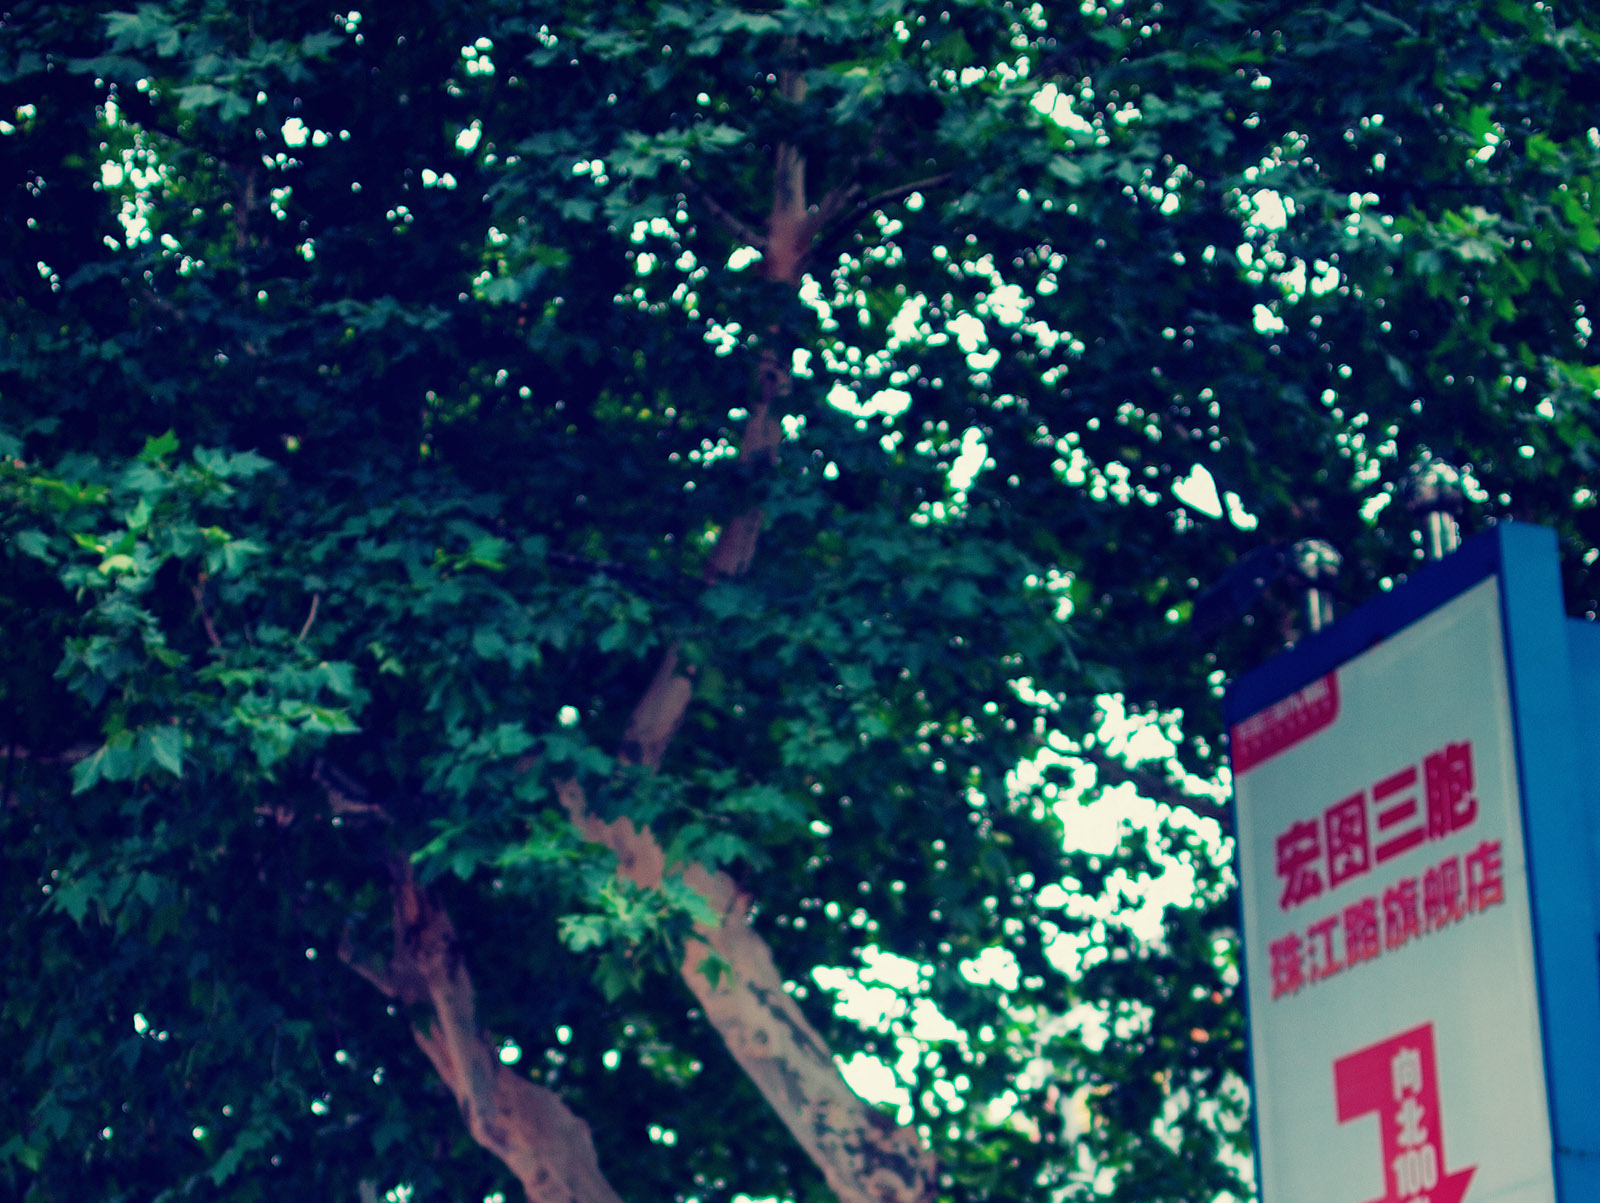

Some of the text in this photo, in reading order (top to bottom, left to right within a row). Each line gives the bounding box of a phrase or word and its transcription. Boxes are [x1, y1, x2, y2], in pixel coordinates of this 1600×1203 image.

[1275, 739, 1479, 912] 宏图三胞
[1269, 840, 1504, 999] 珠江路旗舰店
